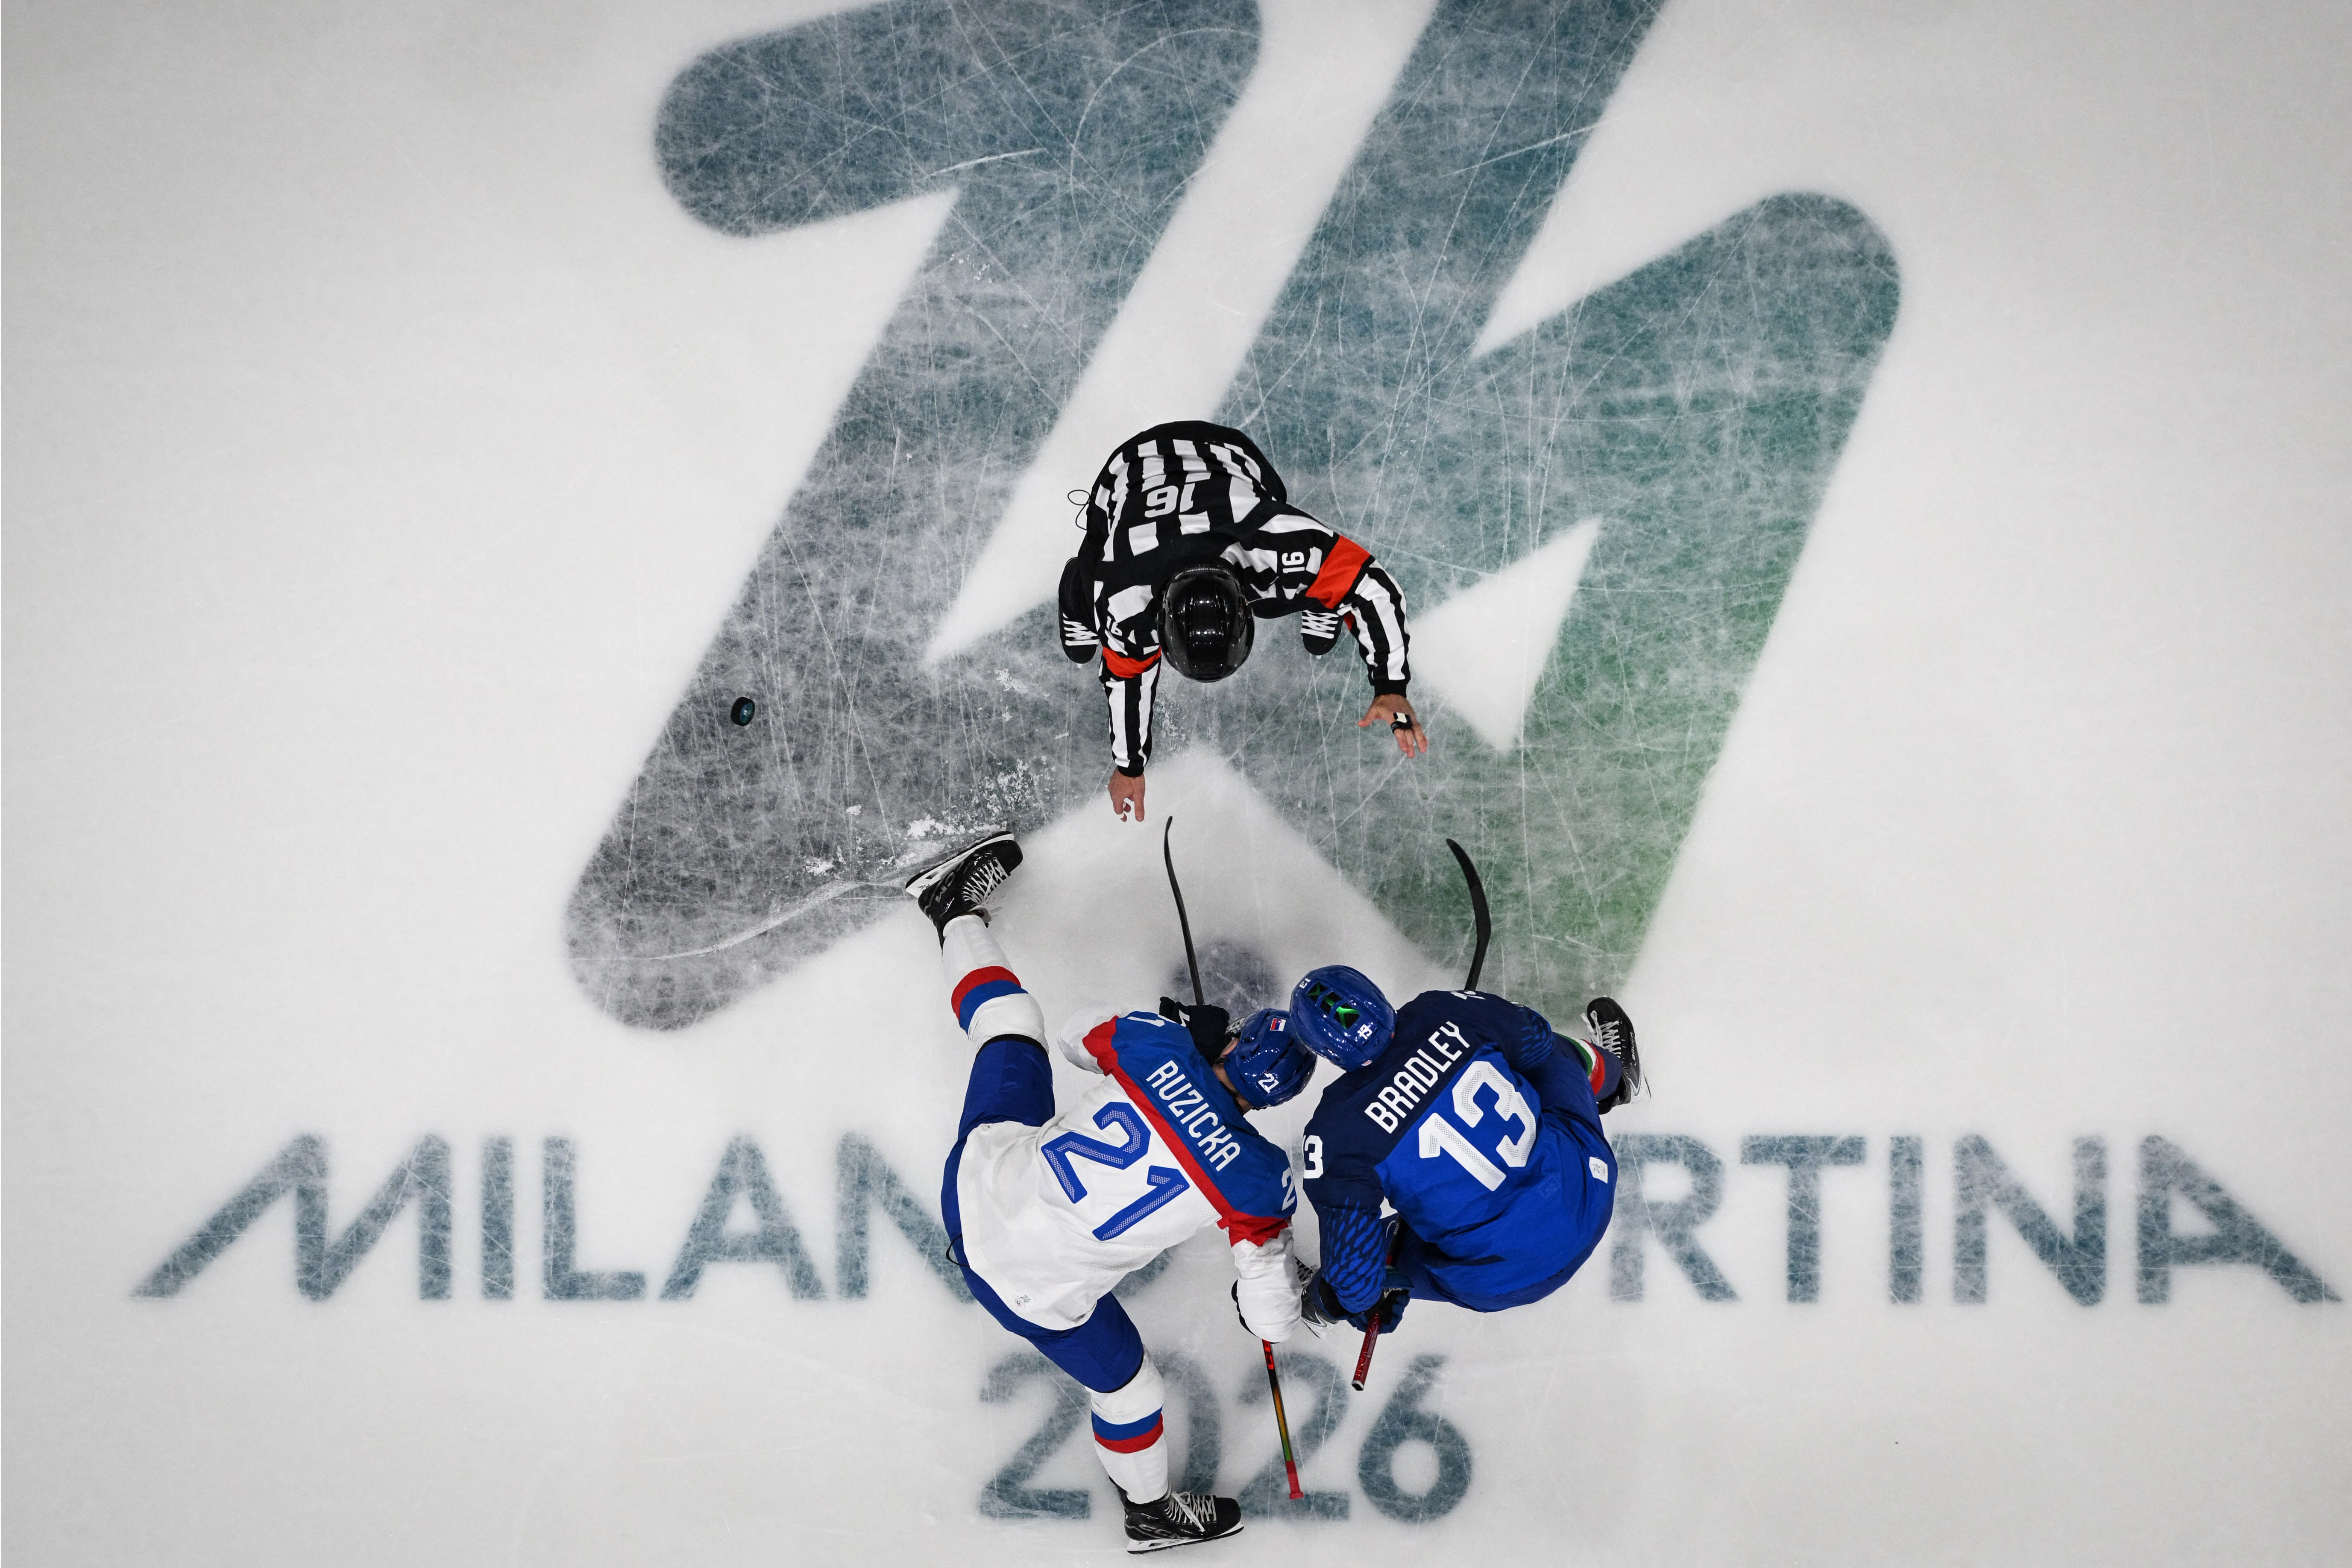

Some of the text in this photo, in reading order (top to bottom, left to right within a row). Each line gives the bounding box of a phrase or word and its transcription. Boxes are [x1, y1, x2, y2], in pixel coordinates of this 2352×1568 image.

[1144, 483, 1195, 518] 16
[1282, 551, 1305, 574] 16
[1106, 615, 1122, 636] 16
[1299, 978, 1311, 988] 13
[1357, 1024, 1372, 1040] 13
[1258, 1073, 1279, 1093] 21
[1364, 1021, 1470, 1134] BRADLEY
[1147, 1060, 1241, 1172] RUZICKA
[1419, 1061, 1537, 1192] 13
[1041, 1102, 1190, 1241] 21
[1303, 1135, 1323, 1179] 3
[130, 1133, 2343, 1306] MILAN RTINA
